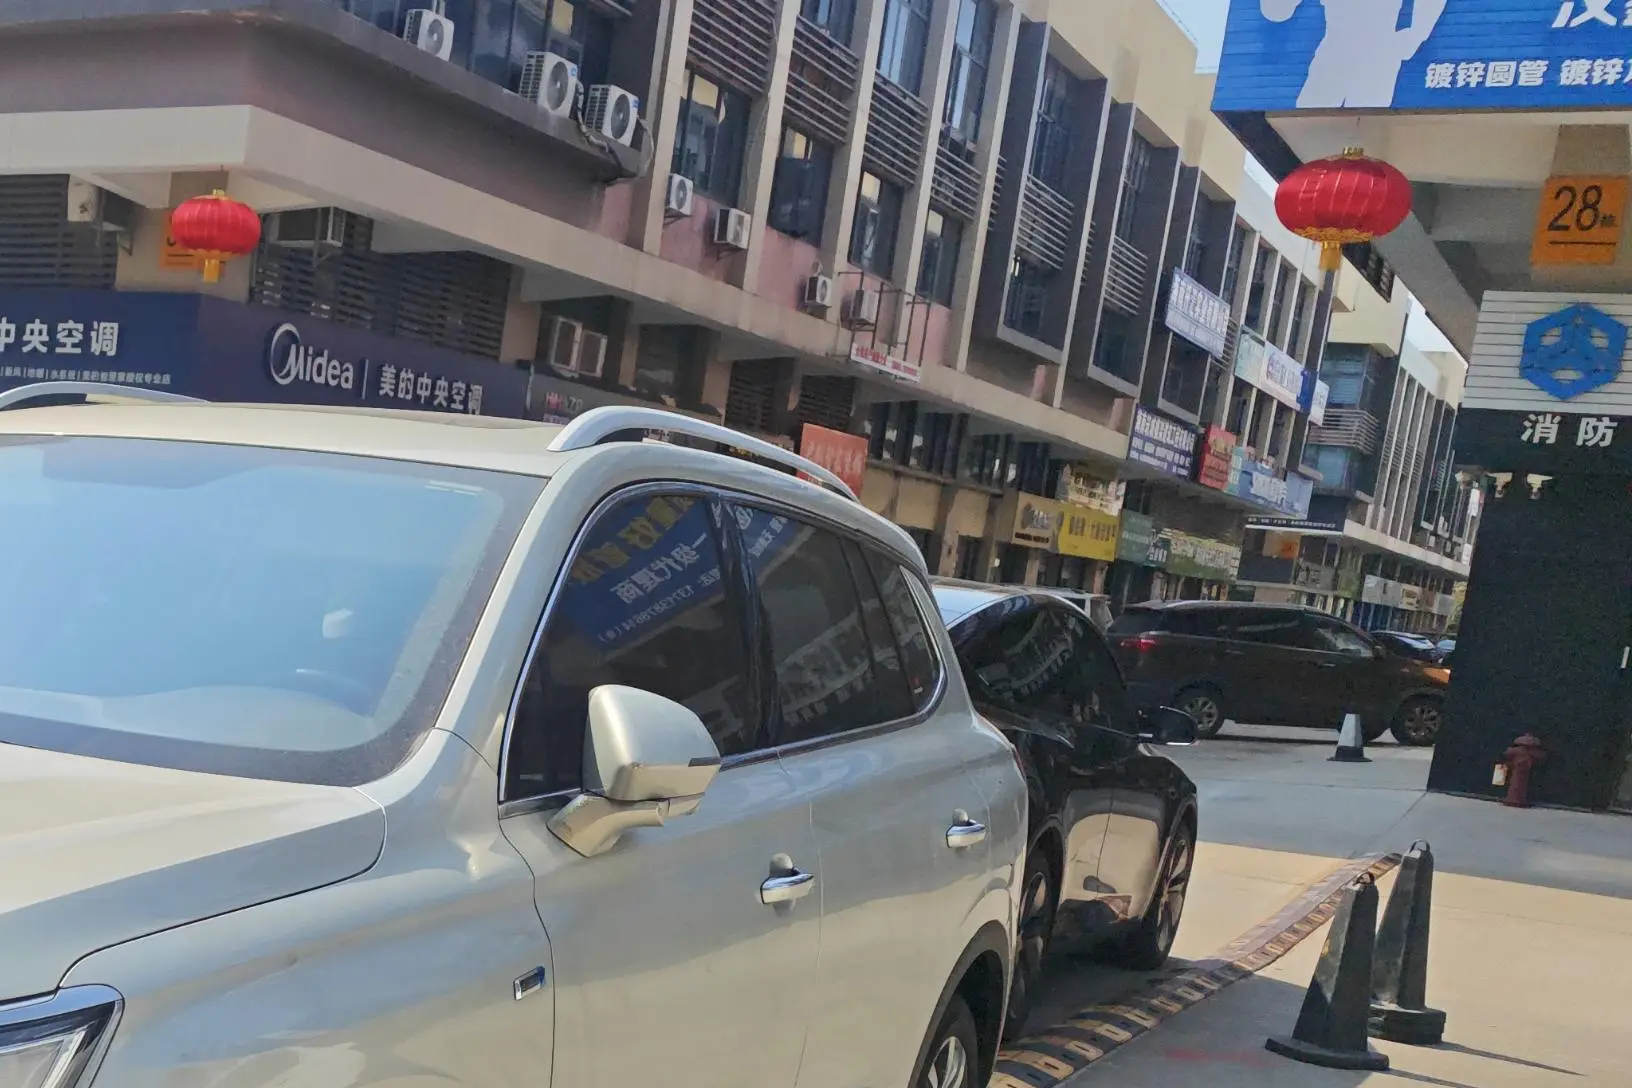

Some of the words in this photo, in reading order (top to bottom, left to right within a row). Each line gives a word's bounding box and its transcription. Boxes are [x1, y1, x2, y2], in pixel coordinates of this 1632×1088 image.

[1425, 60, 1548, 88] 镀锌圆管
[270, 322, 355, 386] Midea
[378, 363, 484, 416] 美的中央空调
[1520, 413, 1618, 448] 消防
